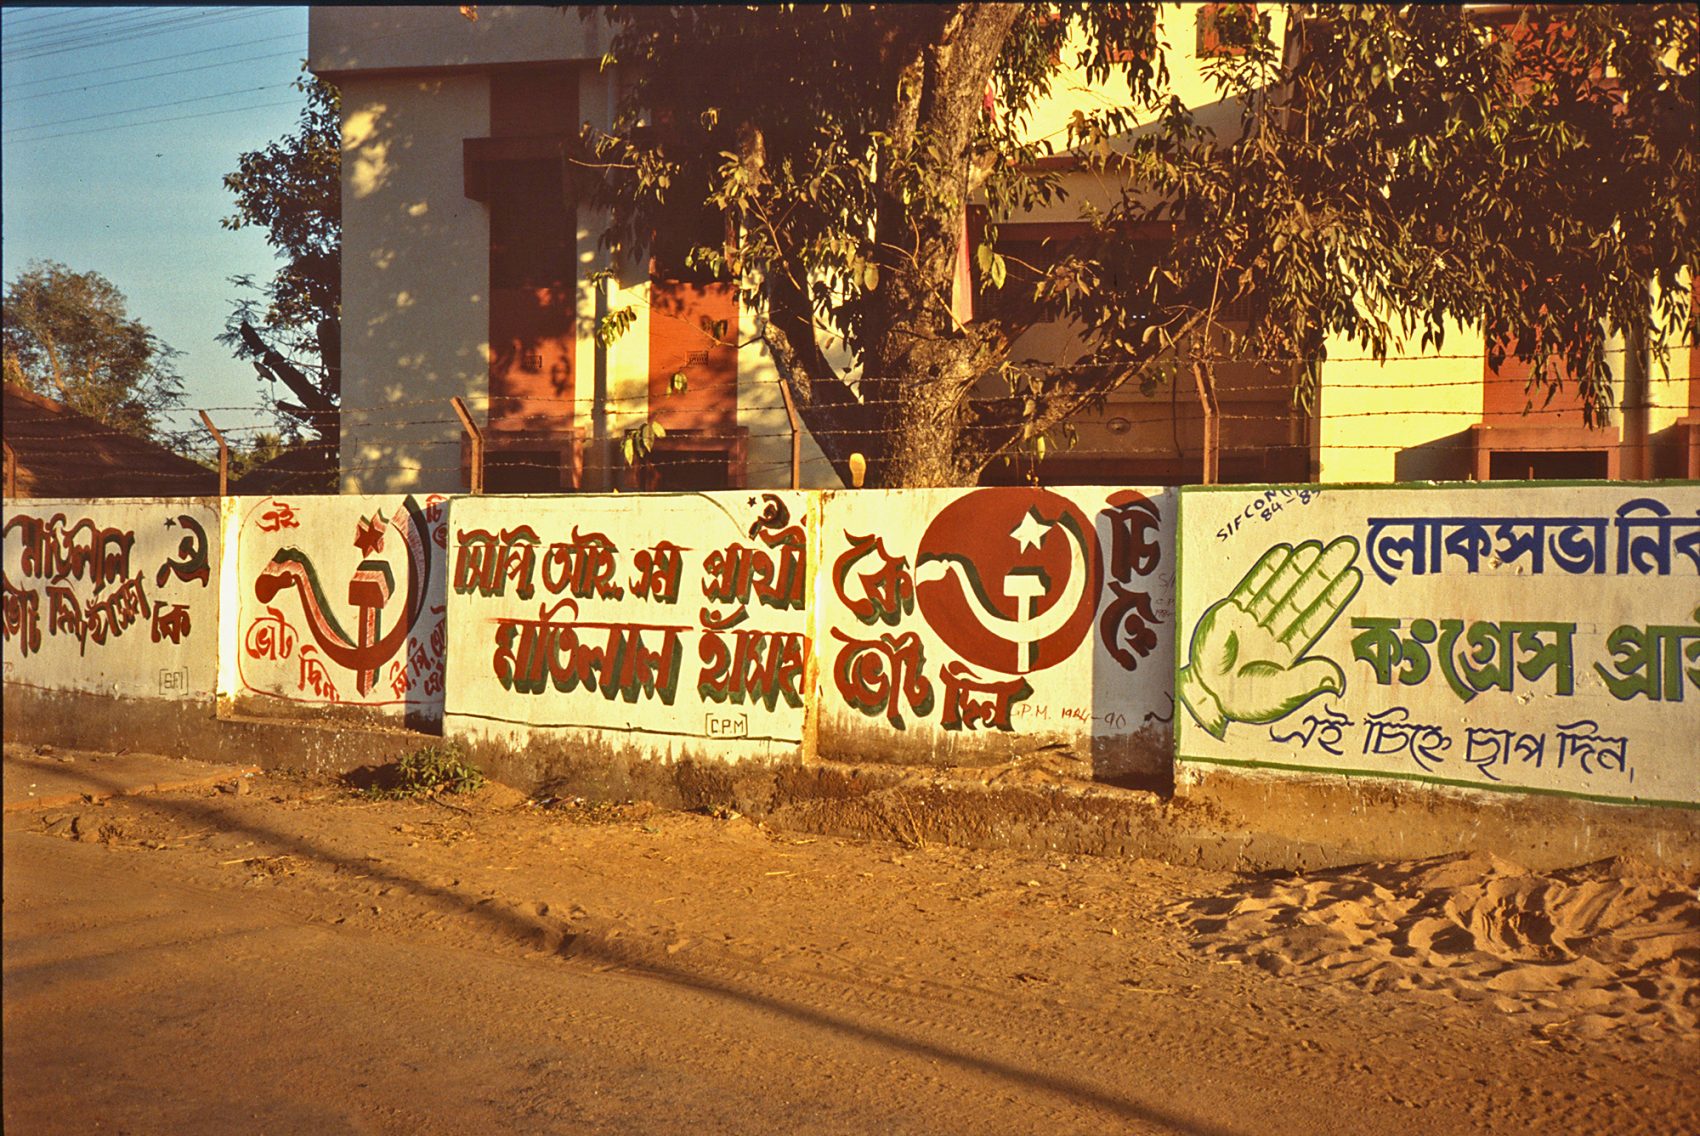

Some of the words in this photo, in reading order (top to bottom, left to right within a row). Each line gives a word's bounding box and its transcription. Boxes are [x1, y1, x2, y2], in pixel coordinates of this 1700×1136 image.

[255, 501, 301, 532] এই
[1366, 517, 1609, 585] লোকসভা
[246, 606, 299, 661] ভোট
[1351, 617, 1576, 702] কংগ্রেস
[829, 625, 934, 731] ভোট
[1270, 703, 1355, 755] এই
[1465, 727, 1546, 781] ছাপ
